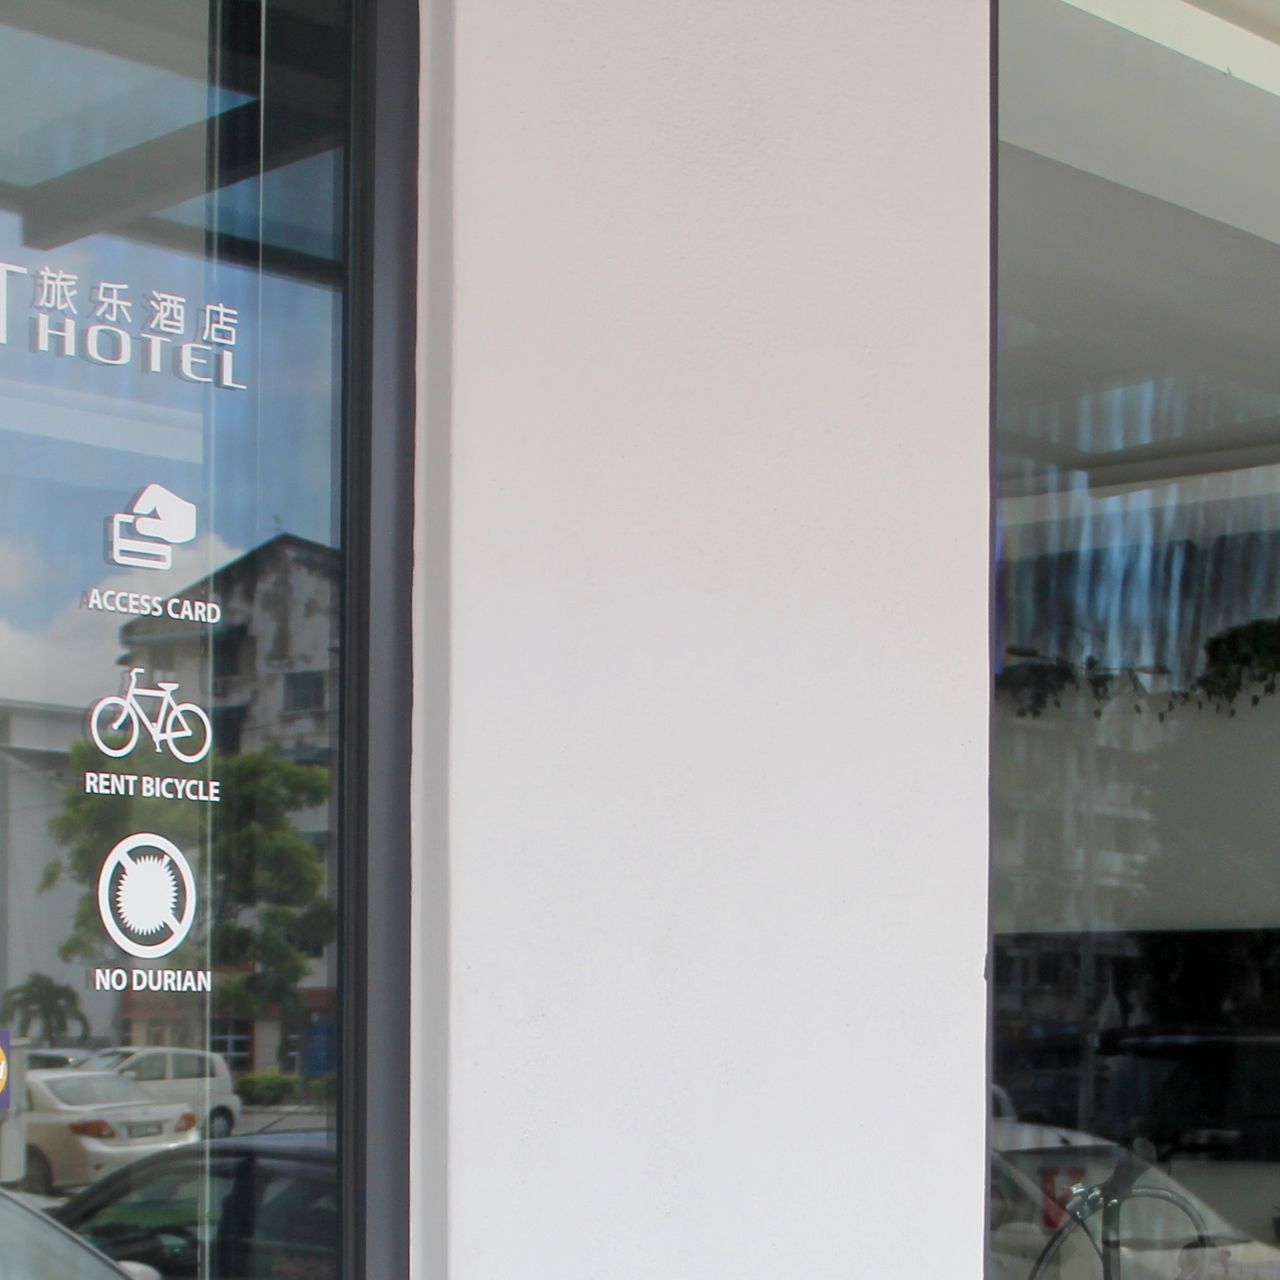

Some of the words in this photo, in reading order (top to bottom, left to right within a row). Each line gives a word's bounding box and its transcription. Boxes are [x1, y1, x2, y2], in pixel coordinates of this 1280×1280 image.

[39, 266, 239, 345] 旅乐酒店
[38, 313, 248, 390] HOTEL
[88, 589, 162, 617] ACCESS
[167, 597, 222, 624] CARD
[85, 771, 138, 797] RENT
[142, 775, 221, 803] BICYCLE
[94, 968, 126, 992] NO
[131, 968, 212, 993] DURIAN
